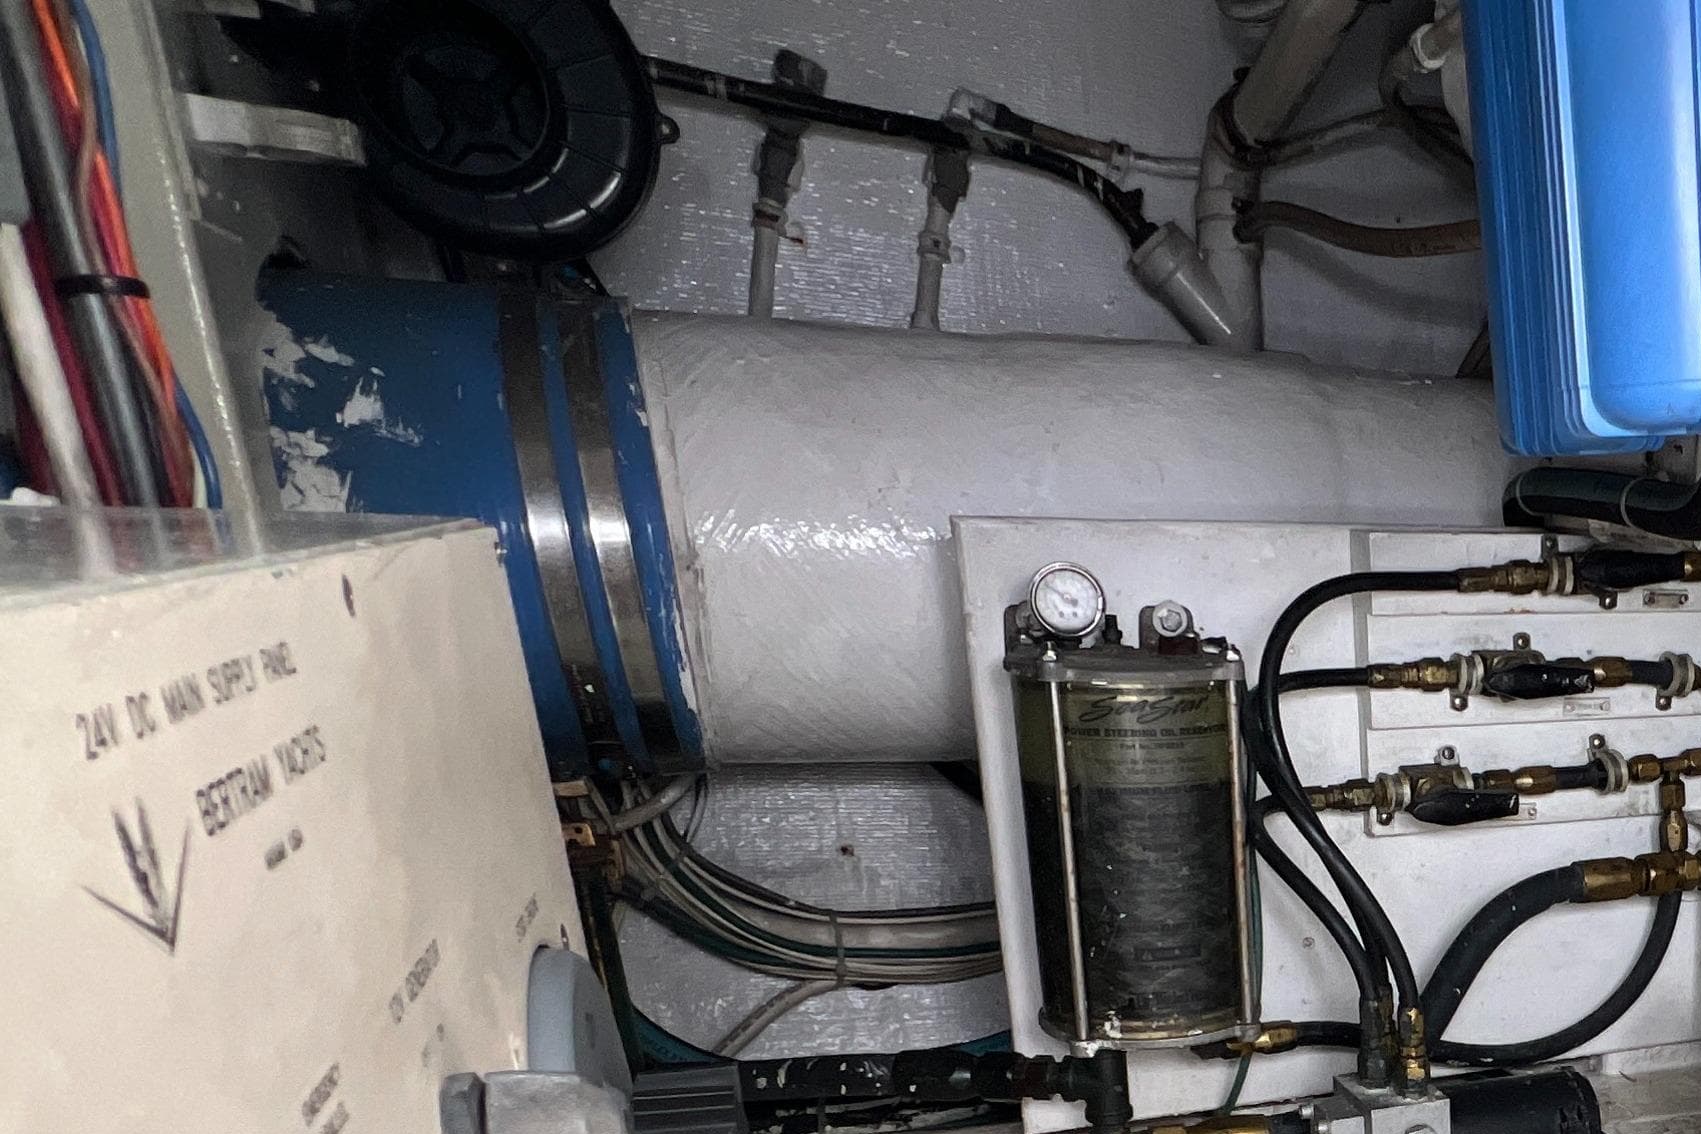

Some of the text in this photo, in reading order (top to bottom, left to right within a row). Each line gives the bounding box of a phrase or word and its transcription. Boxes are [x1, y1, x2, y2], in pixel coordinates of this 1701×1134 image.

[76, 703, 119, 760] 24V
[125, 691, 157, 739] DC
[160, 672, 206, 725] MAIN
[1078, 695, 1209, 724] SeaStar
[195, 725, 327, 836] BERTRAM YACHTS
